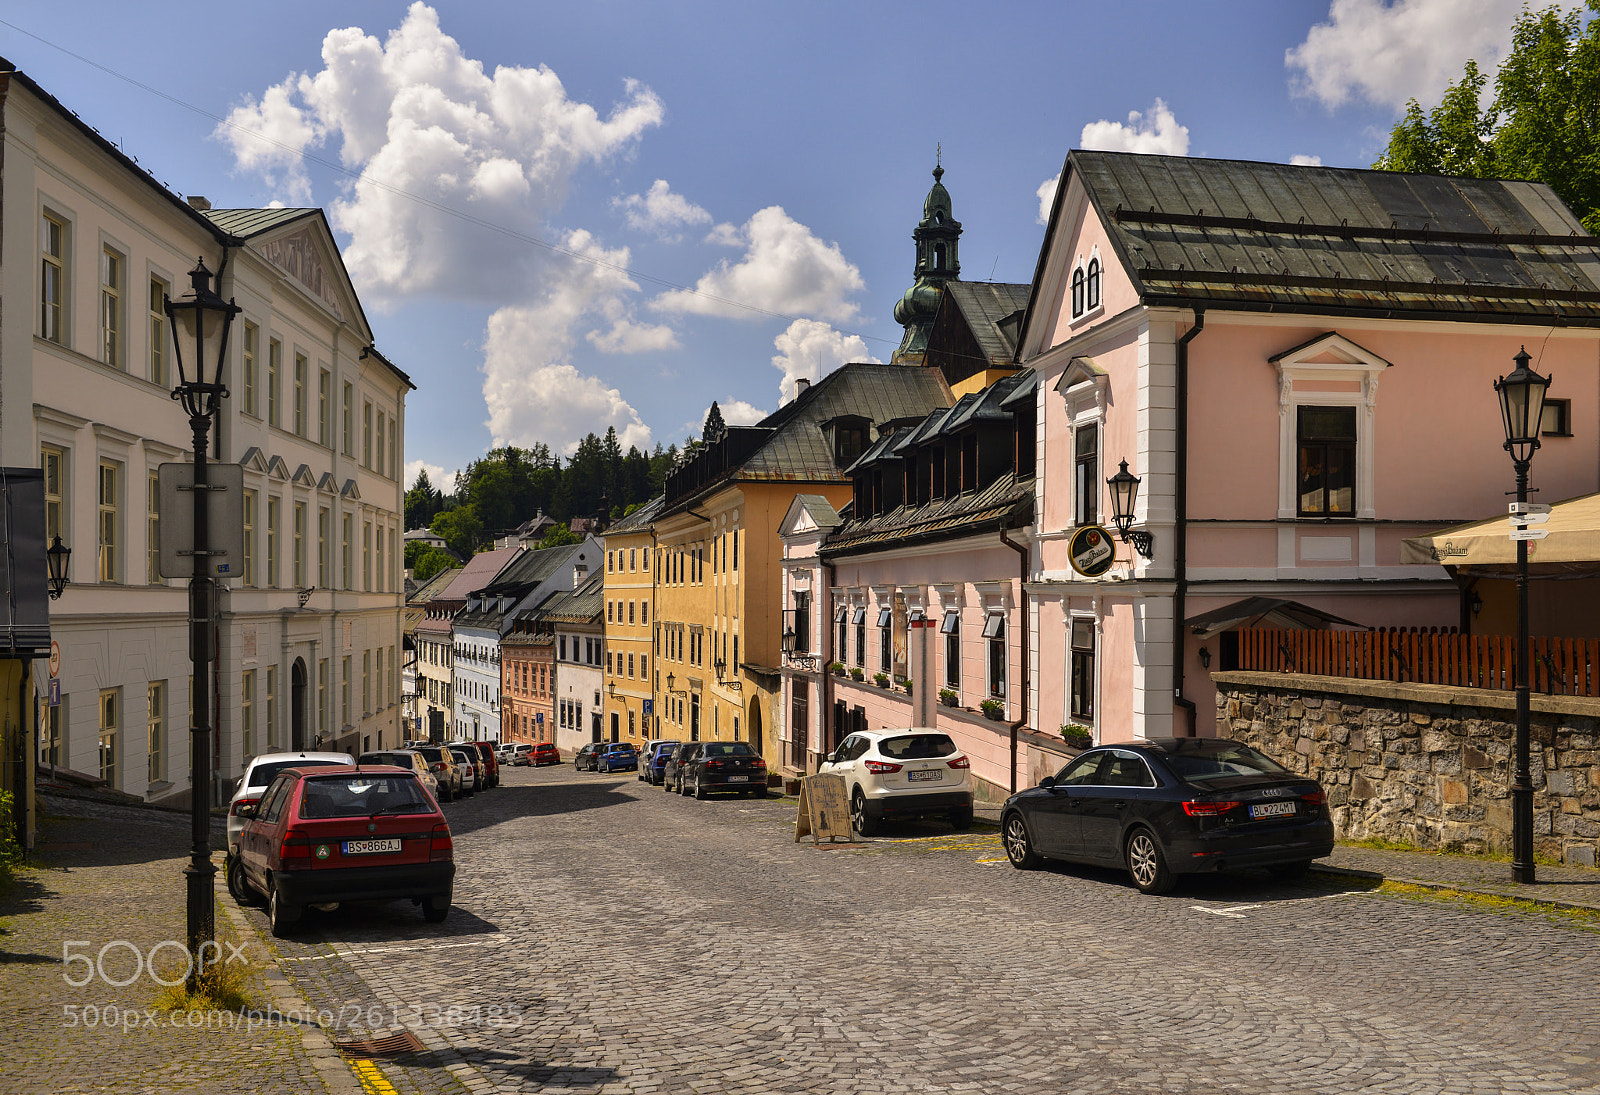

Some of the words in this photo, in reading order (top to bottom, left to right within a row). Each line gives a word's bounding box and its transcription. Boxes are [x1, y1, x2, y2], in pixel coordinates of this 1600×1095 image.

[1269, 803, 1294, 814] 224MT
[348, 841, 362, 853] BS
[367, 840, 400, 851] 866AJ
